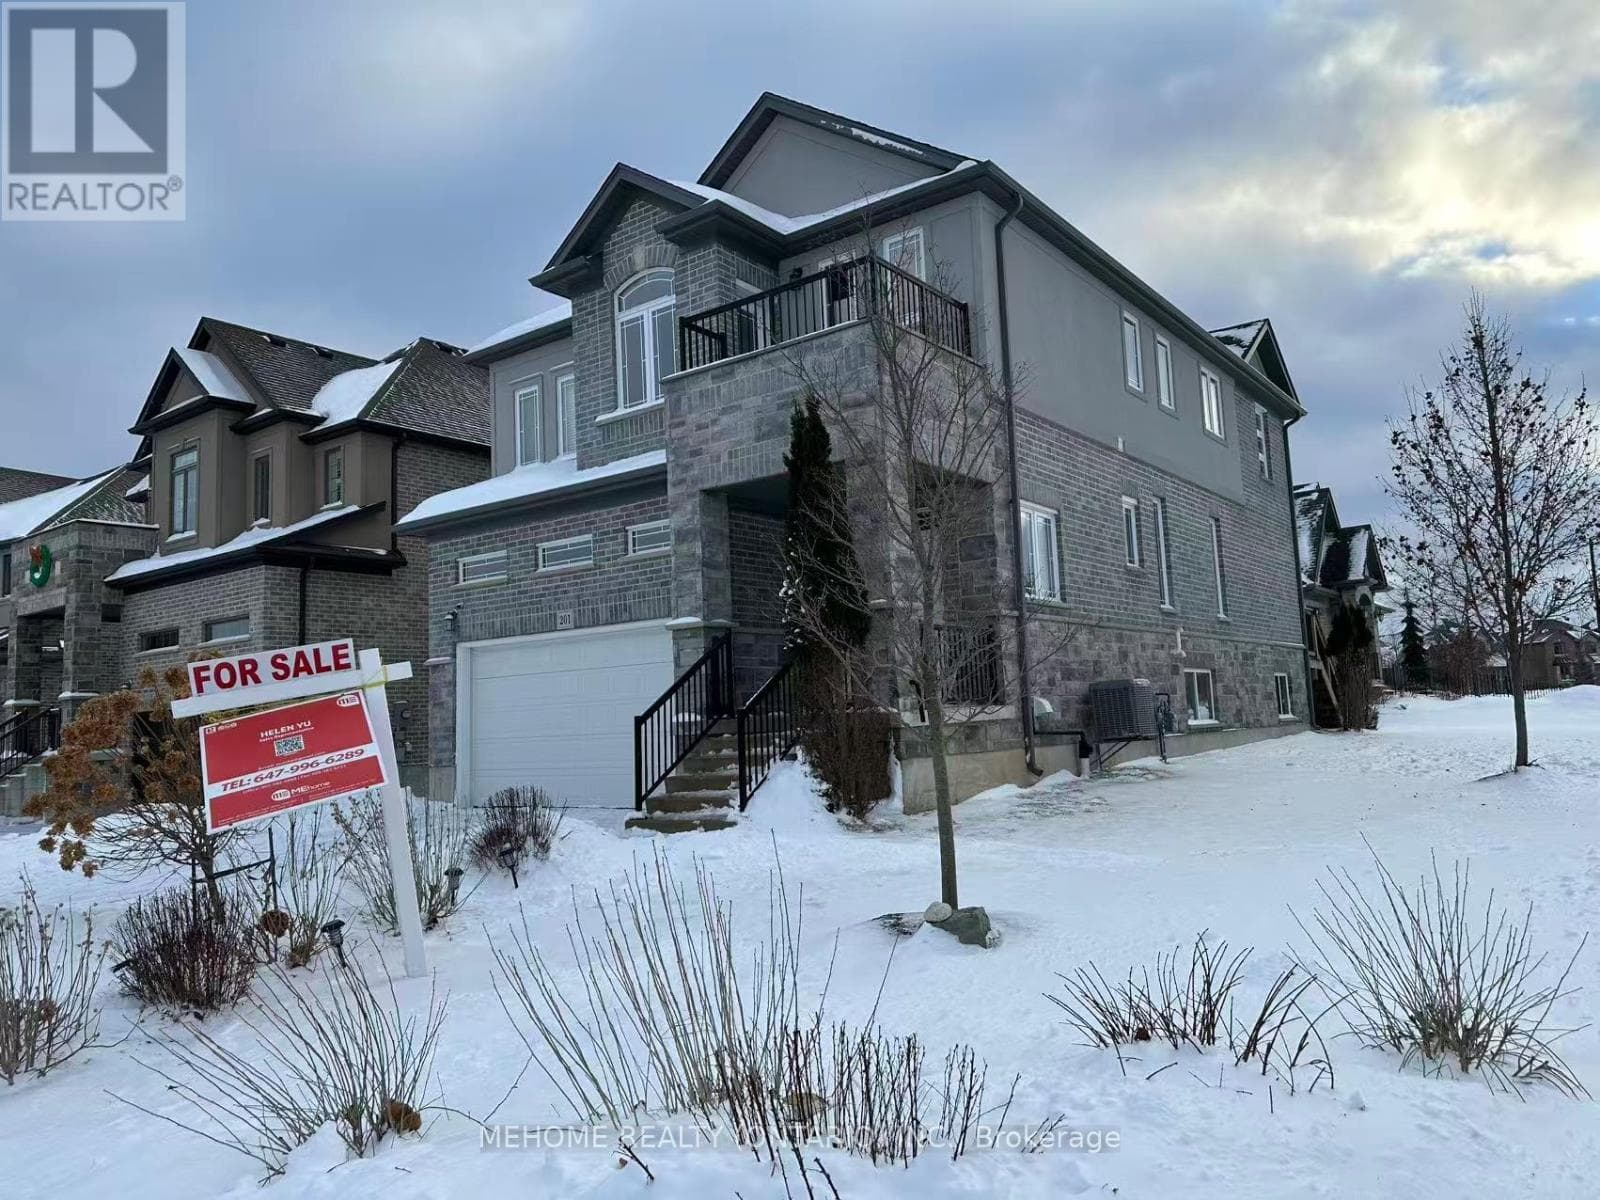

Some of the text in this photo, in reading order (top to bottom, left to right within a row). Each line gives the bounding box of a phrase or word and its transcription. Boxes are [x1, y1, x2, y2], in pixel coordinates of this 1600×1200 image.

[192, 643, 352, 694] FOR SALE
[260, 720, 311, 738] HELEN YU
[221, 777, 252, 792] TEL:
[253, 748, 365, 783] 647-996-6289
